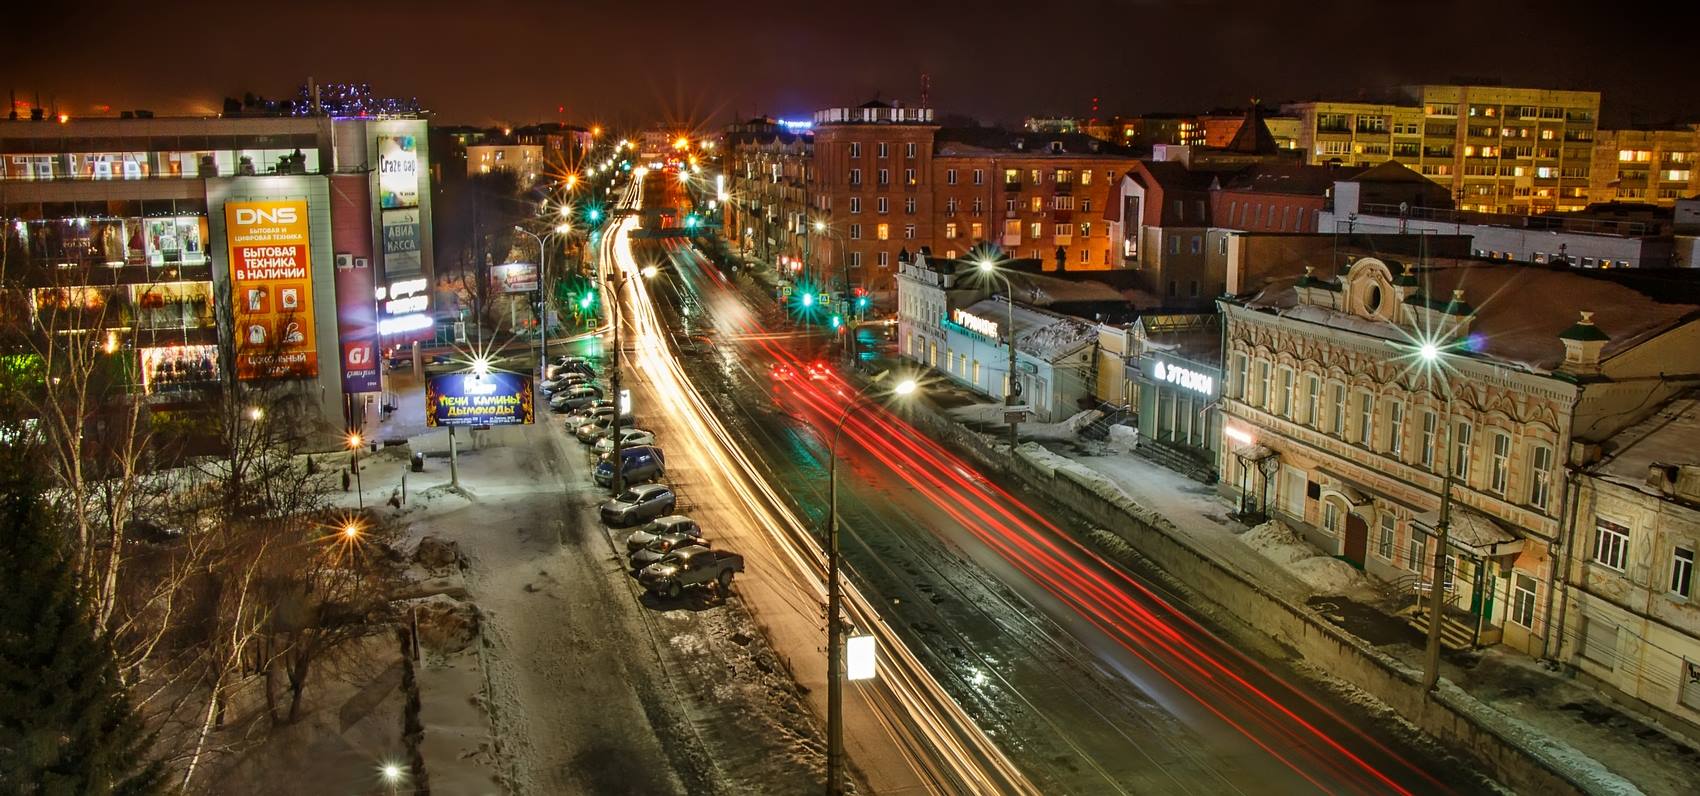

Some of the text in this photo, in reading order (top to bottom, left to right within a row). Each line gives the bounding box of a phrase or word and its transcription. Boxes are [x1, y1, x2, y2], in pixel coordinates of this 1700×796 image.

[380, 154, 401, 173] Craze
[236, 207, 298, 225] DNS
[272, 233, 303, 241] ТЕХНИКА
[388, 225, 414, 238] АВИА
[243, 246, 297, 258] БЫТОВАЯ
[387, 239, 416, 252] КАССА
[244, 257, 297, 269] ТЕХНИКА
[236, 267, 306, 280] В НАЛИЧИИ
[348, 347, 370, 364] GJ
